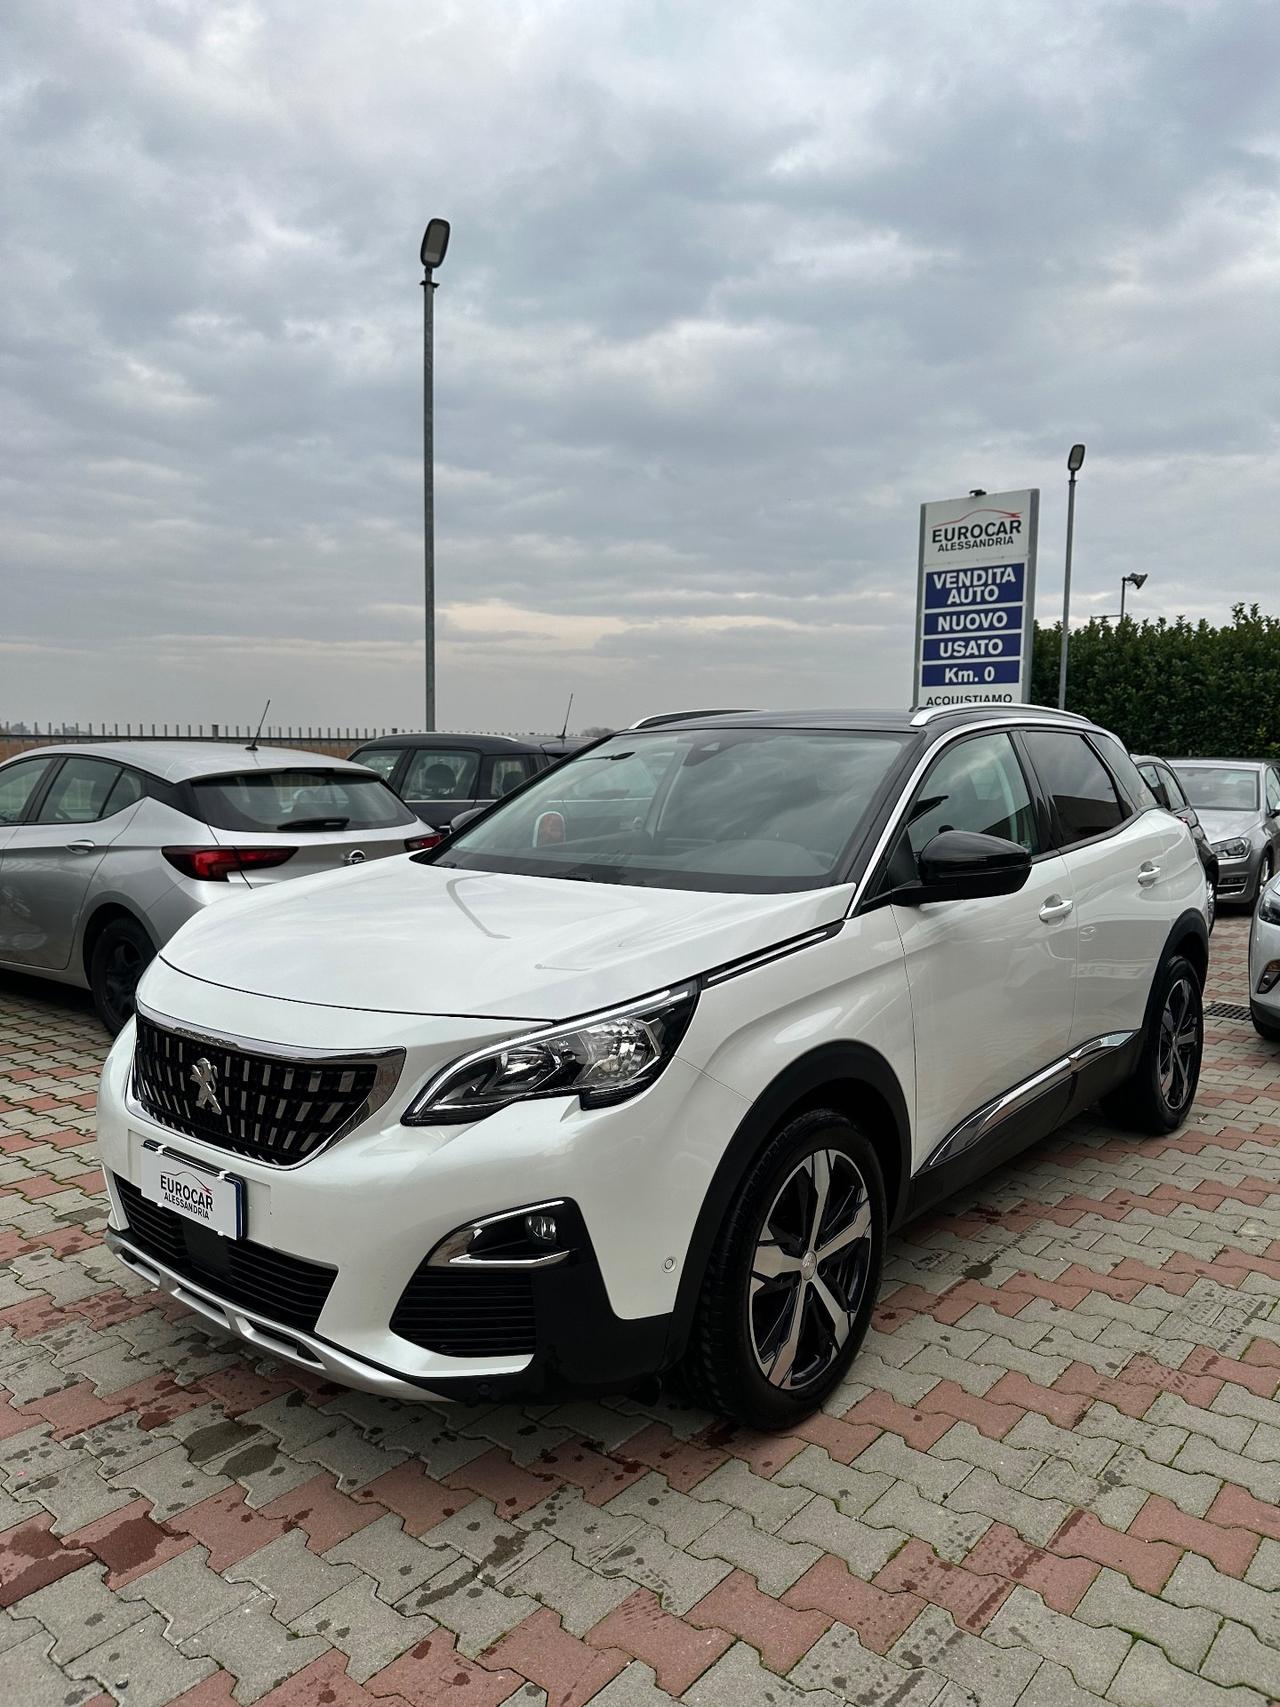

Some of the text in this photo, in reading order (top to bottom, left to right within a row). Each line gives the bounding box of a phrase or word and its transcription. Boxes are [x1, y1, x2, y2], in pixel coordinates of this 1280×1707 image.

[931, 519, 1022, 544] EUROCAR
[937, 536, 1014, 553] ALESSANDRIA
[933, 566, 1016, 590] VENDITA
[946, 584, 999, 605] AUTO
[937, 611, 1008, 632] NUOVO
[939, 638, 1003, 658] USATO
[944, 665, 995, 683] Km. 0
[926, 693, 1013, 706] ACQUISTIAMO
[160, 1174, 214, 1212] EUROCAR
[164, 1192, 210, 1220] ALESSANDRIA
